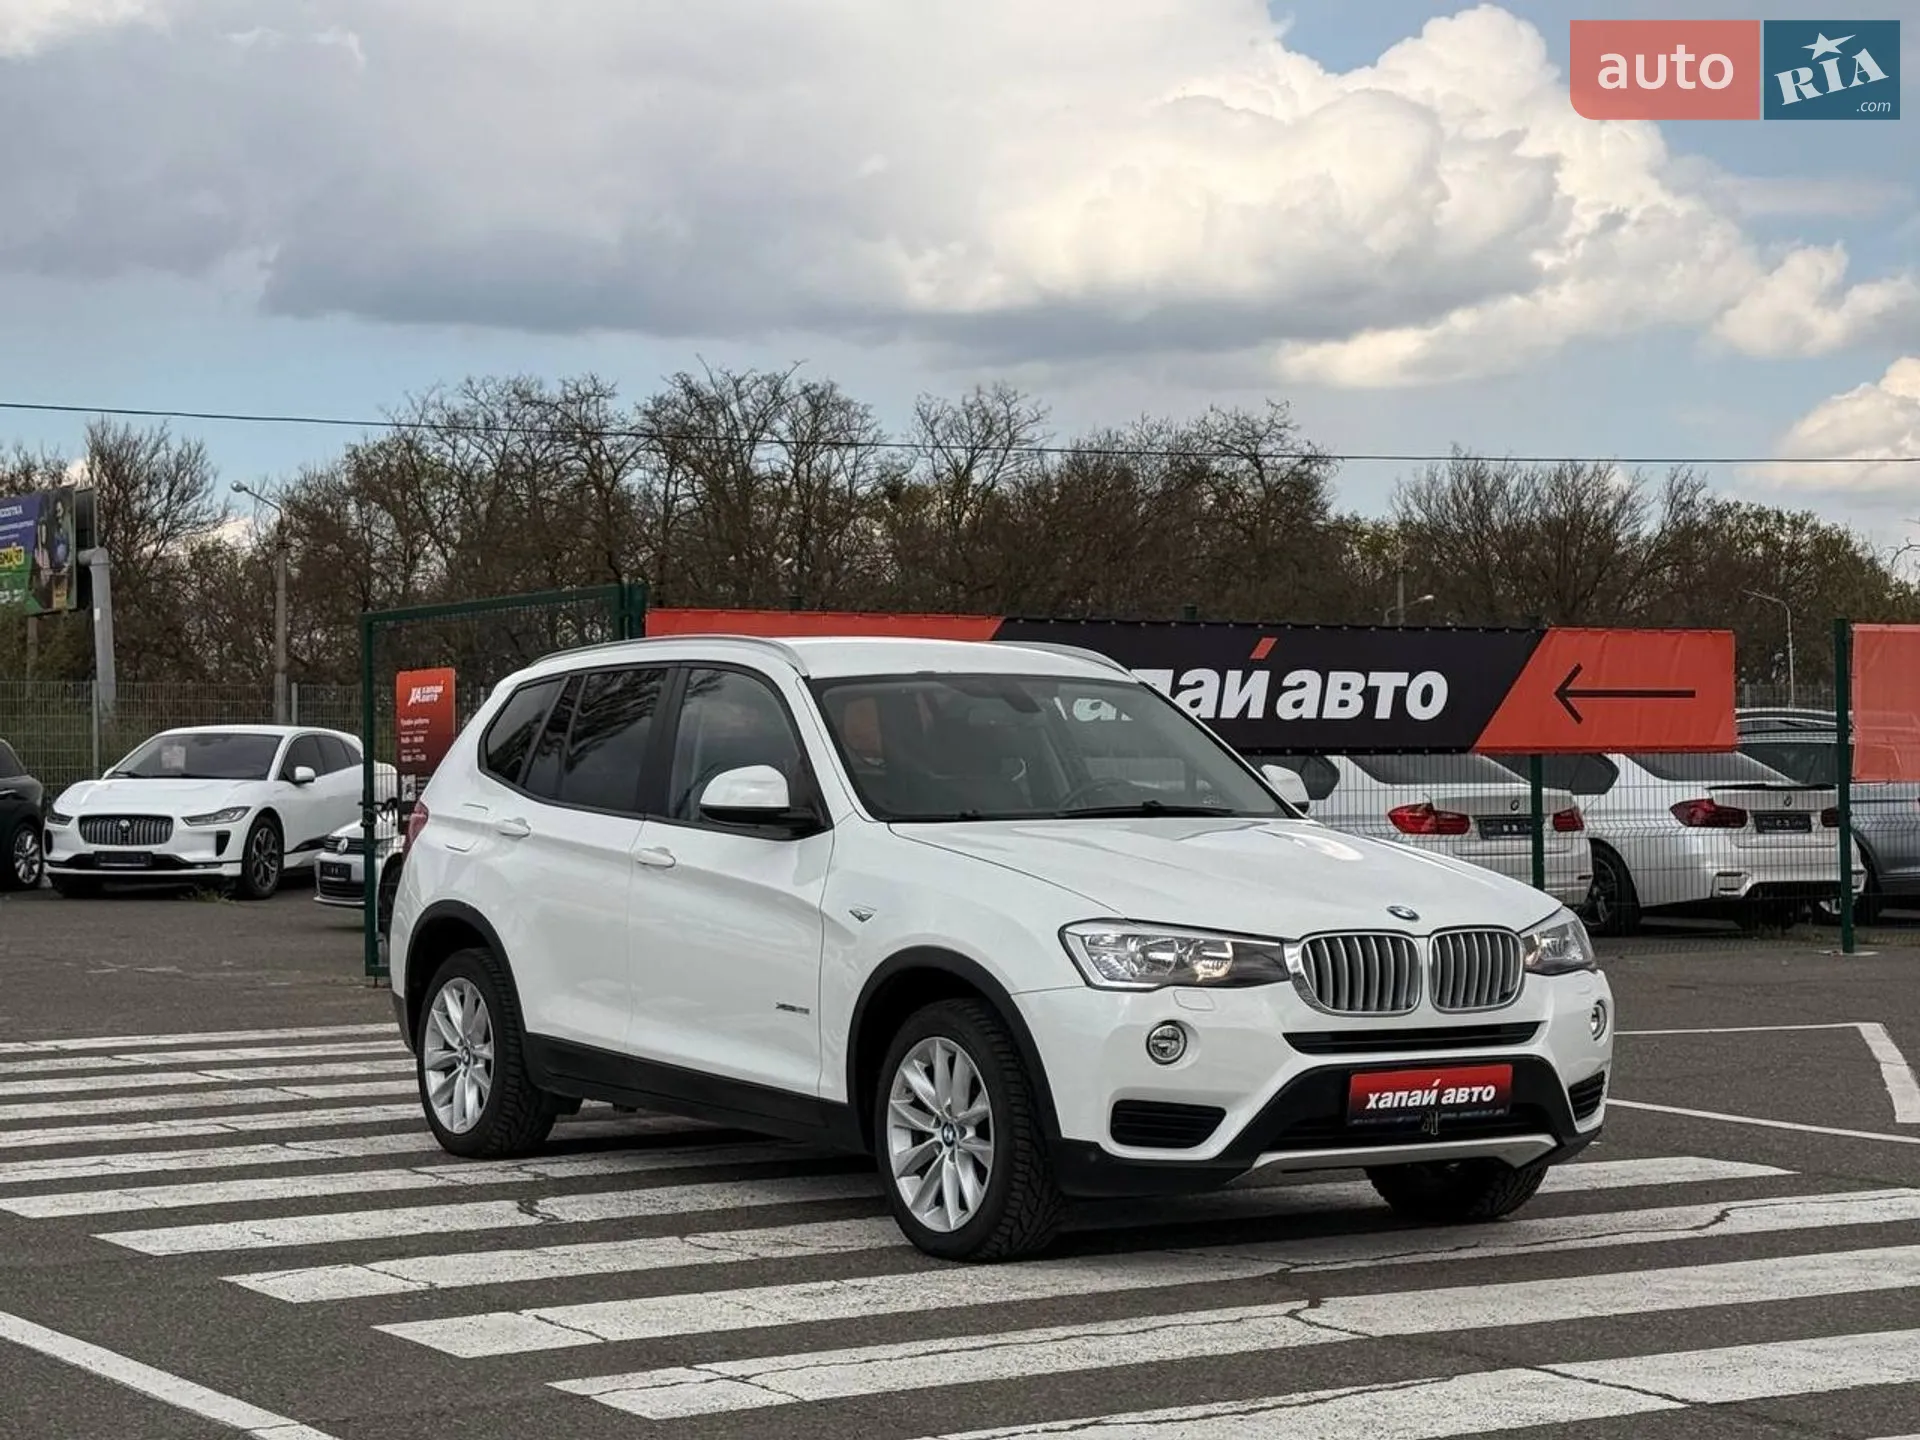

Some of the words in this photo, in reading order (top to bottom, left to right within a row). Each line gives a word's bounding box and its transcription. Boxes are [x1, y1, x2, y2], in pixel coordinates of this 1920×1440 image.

[1276, 670, 1449, 721] авто
[1365, 1078, 1441, 1110] хапай
[1441, 1085, 1496, 1105] авто
